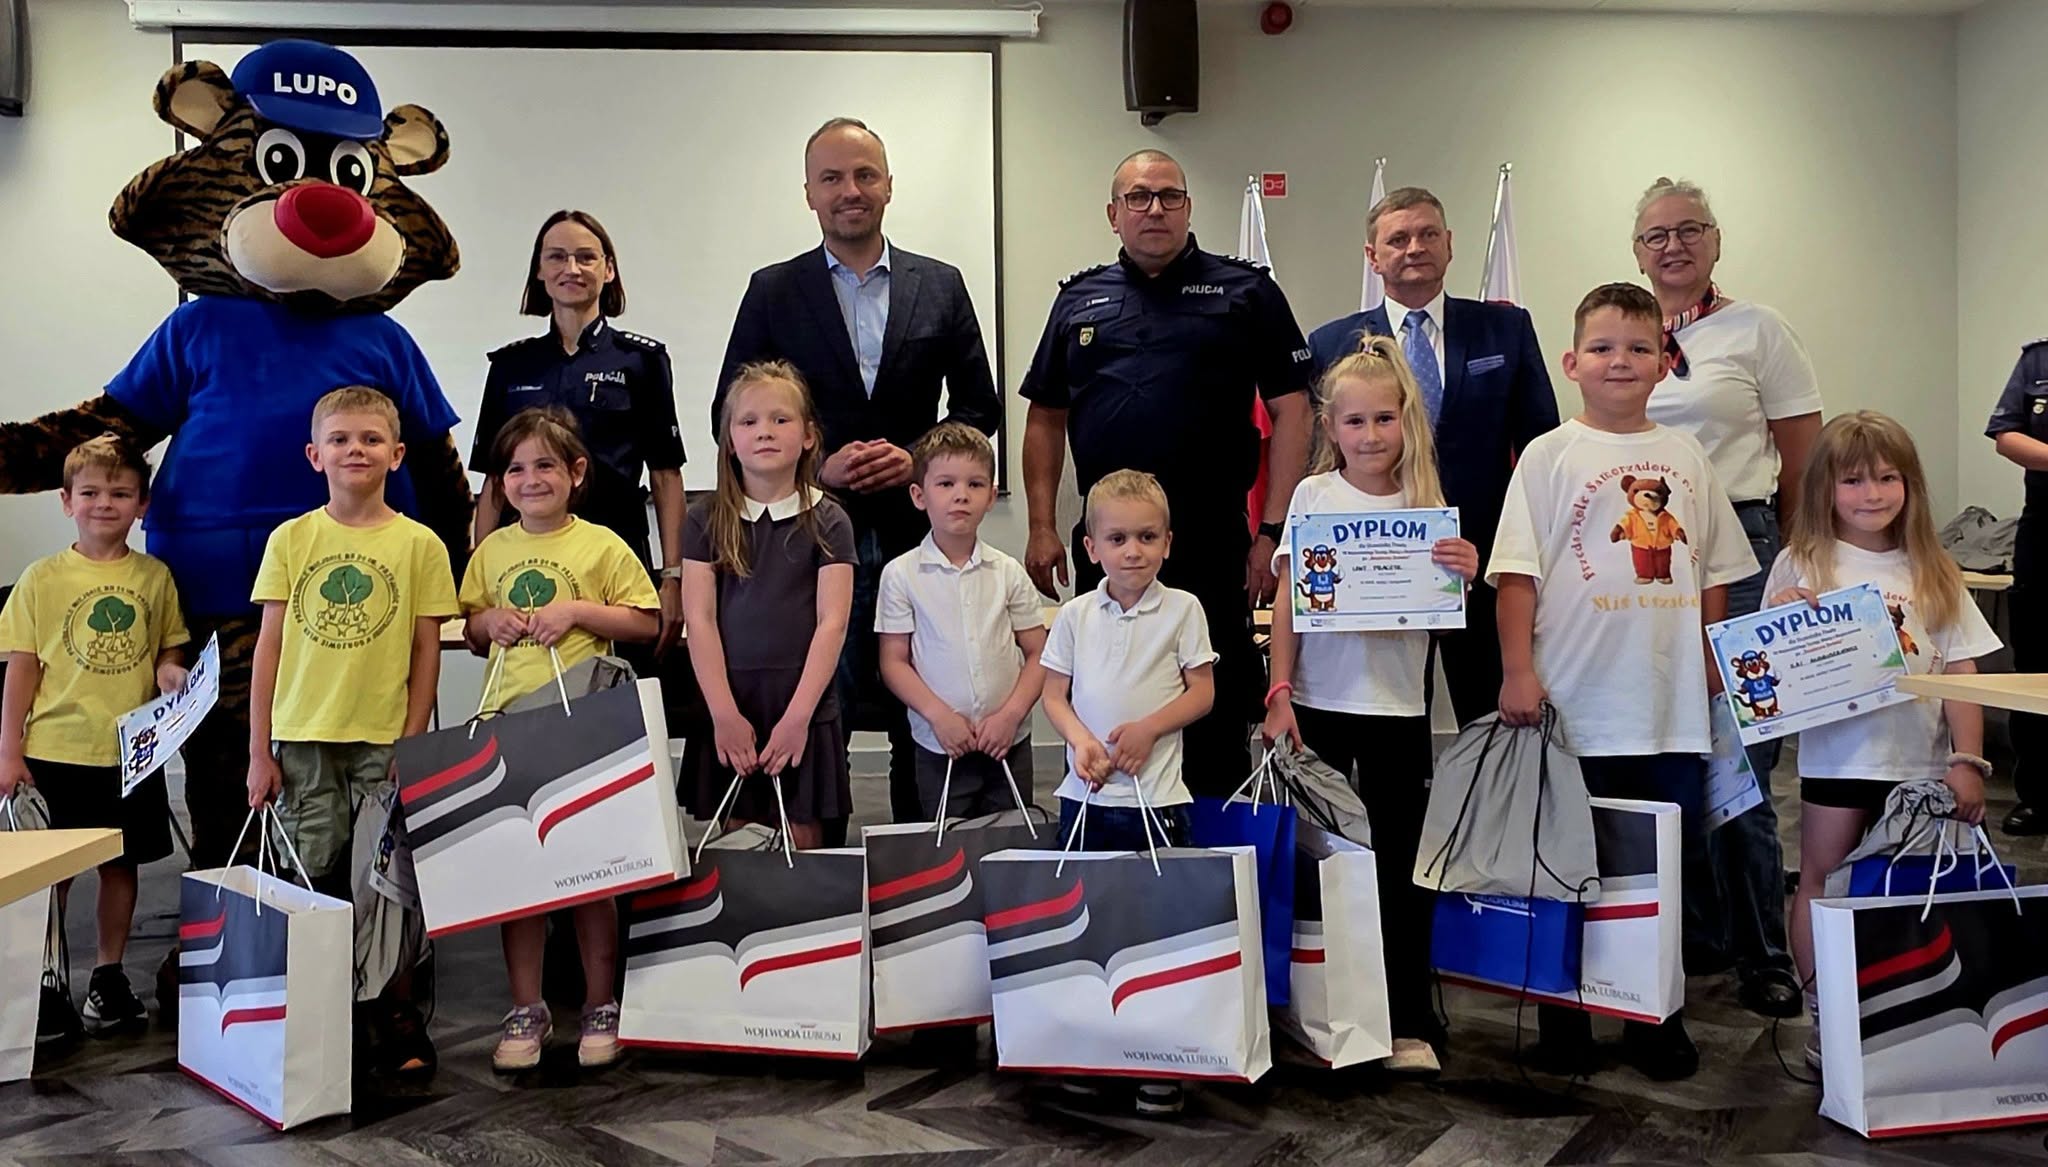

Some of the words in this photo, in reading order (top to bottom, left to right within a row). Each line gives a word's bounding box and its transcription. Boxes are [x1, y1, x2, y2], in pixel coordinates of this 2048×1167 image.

[274, 72, 357, 105] LUPO
[1182, 285, 1224, 295] POLICJA
[1333, 519, 1427, 543] DYPLOM
[1755, 602, 1853, 645] DYPLOM
[153, 661, 205, 721] DYPLOM
[1996, 1092, 2048, 1106] WOJEWOD
